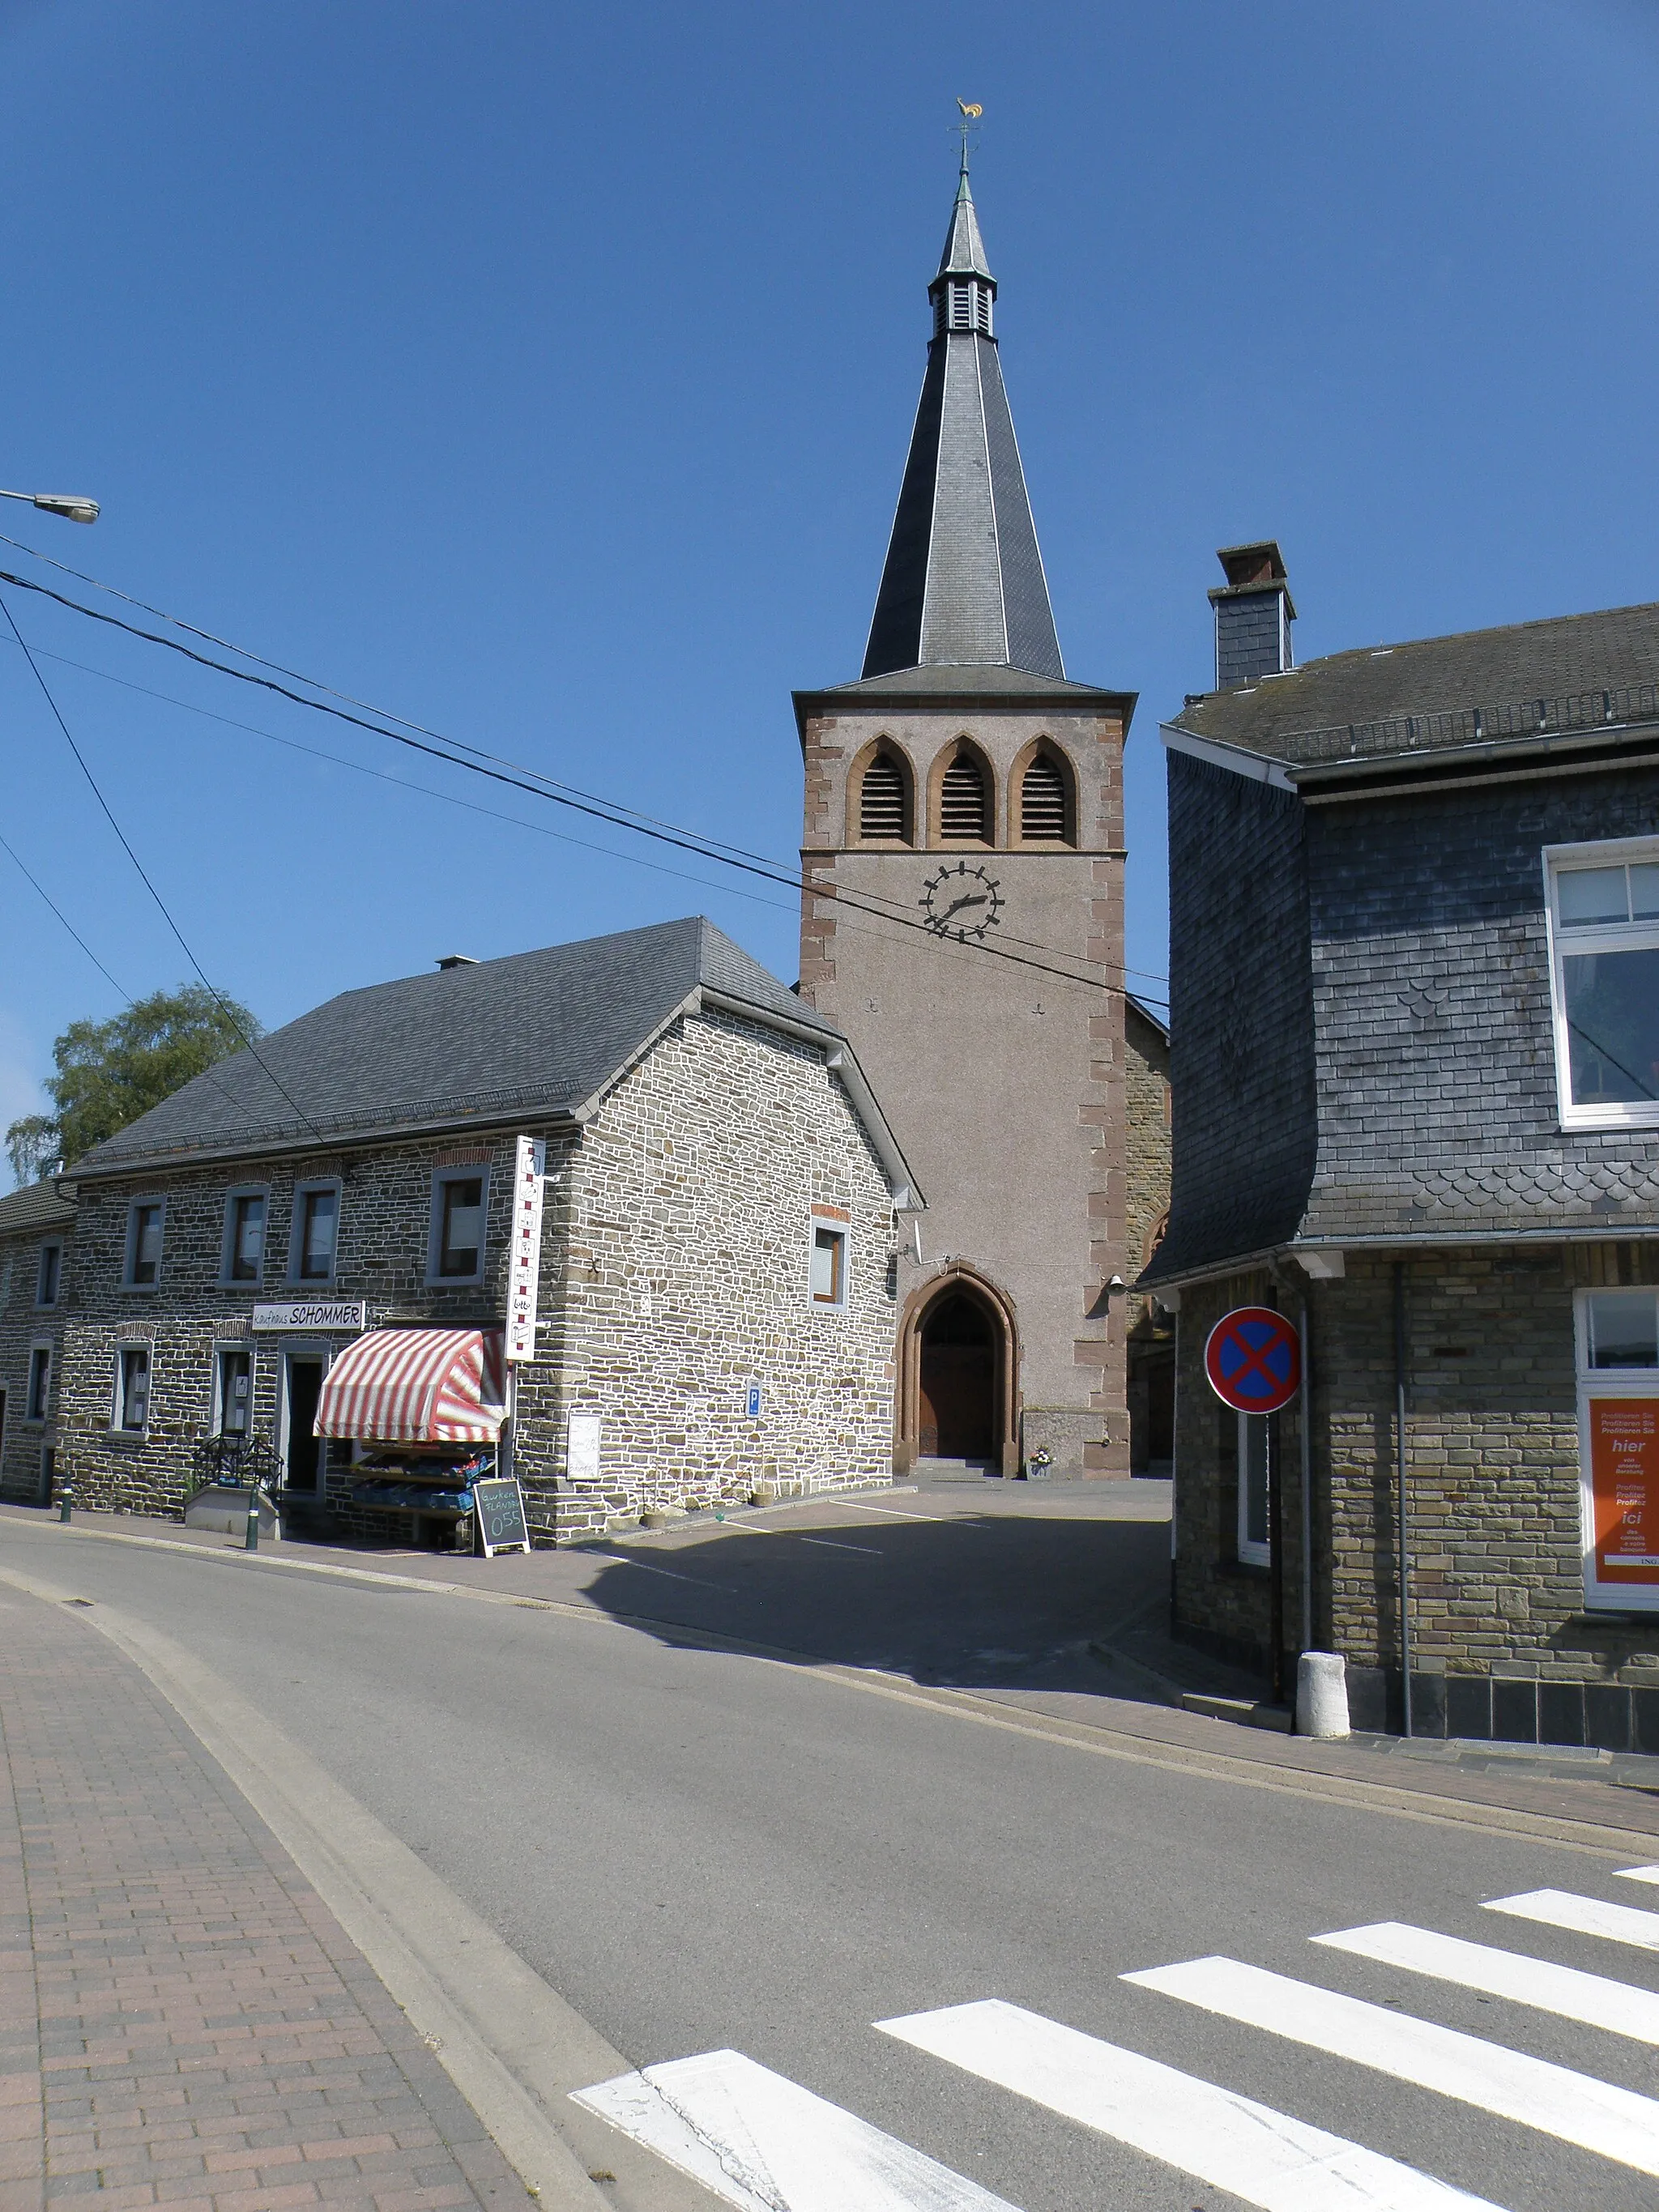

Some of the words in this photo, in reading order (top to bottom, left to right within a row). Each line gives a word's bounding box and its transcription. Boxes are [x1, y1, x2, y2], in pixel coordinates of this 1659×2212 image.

[290, 1306, 360, 1325] SCHOMMER
[751, 1392, 757, 1405] P
[1612, 1439, 1646, 1452] hier
[1622, 1511, 1642, 1524] ici
